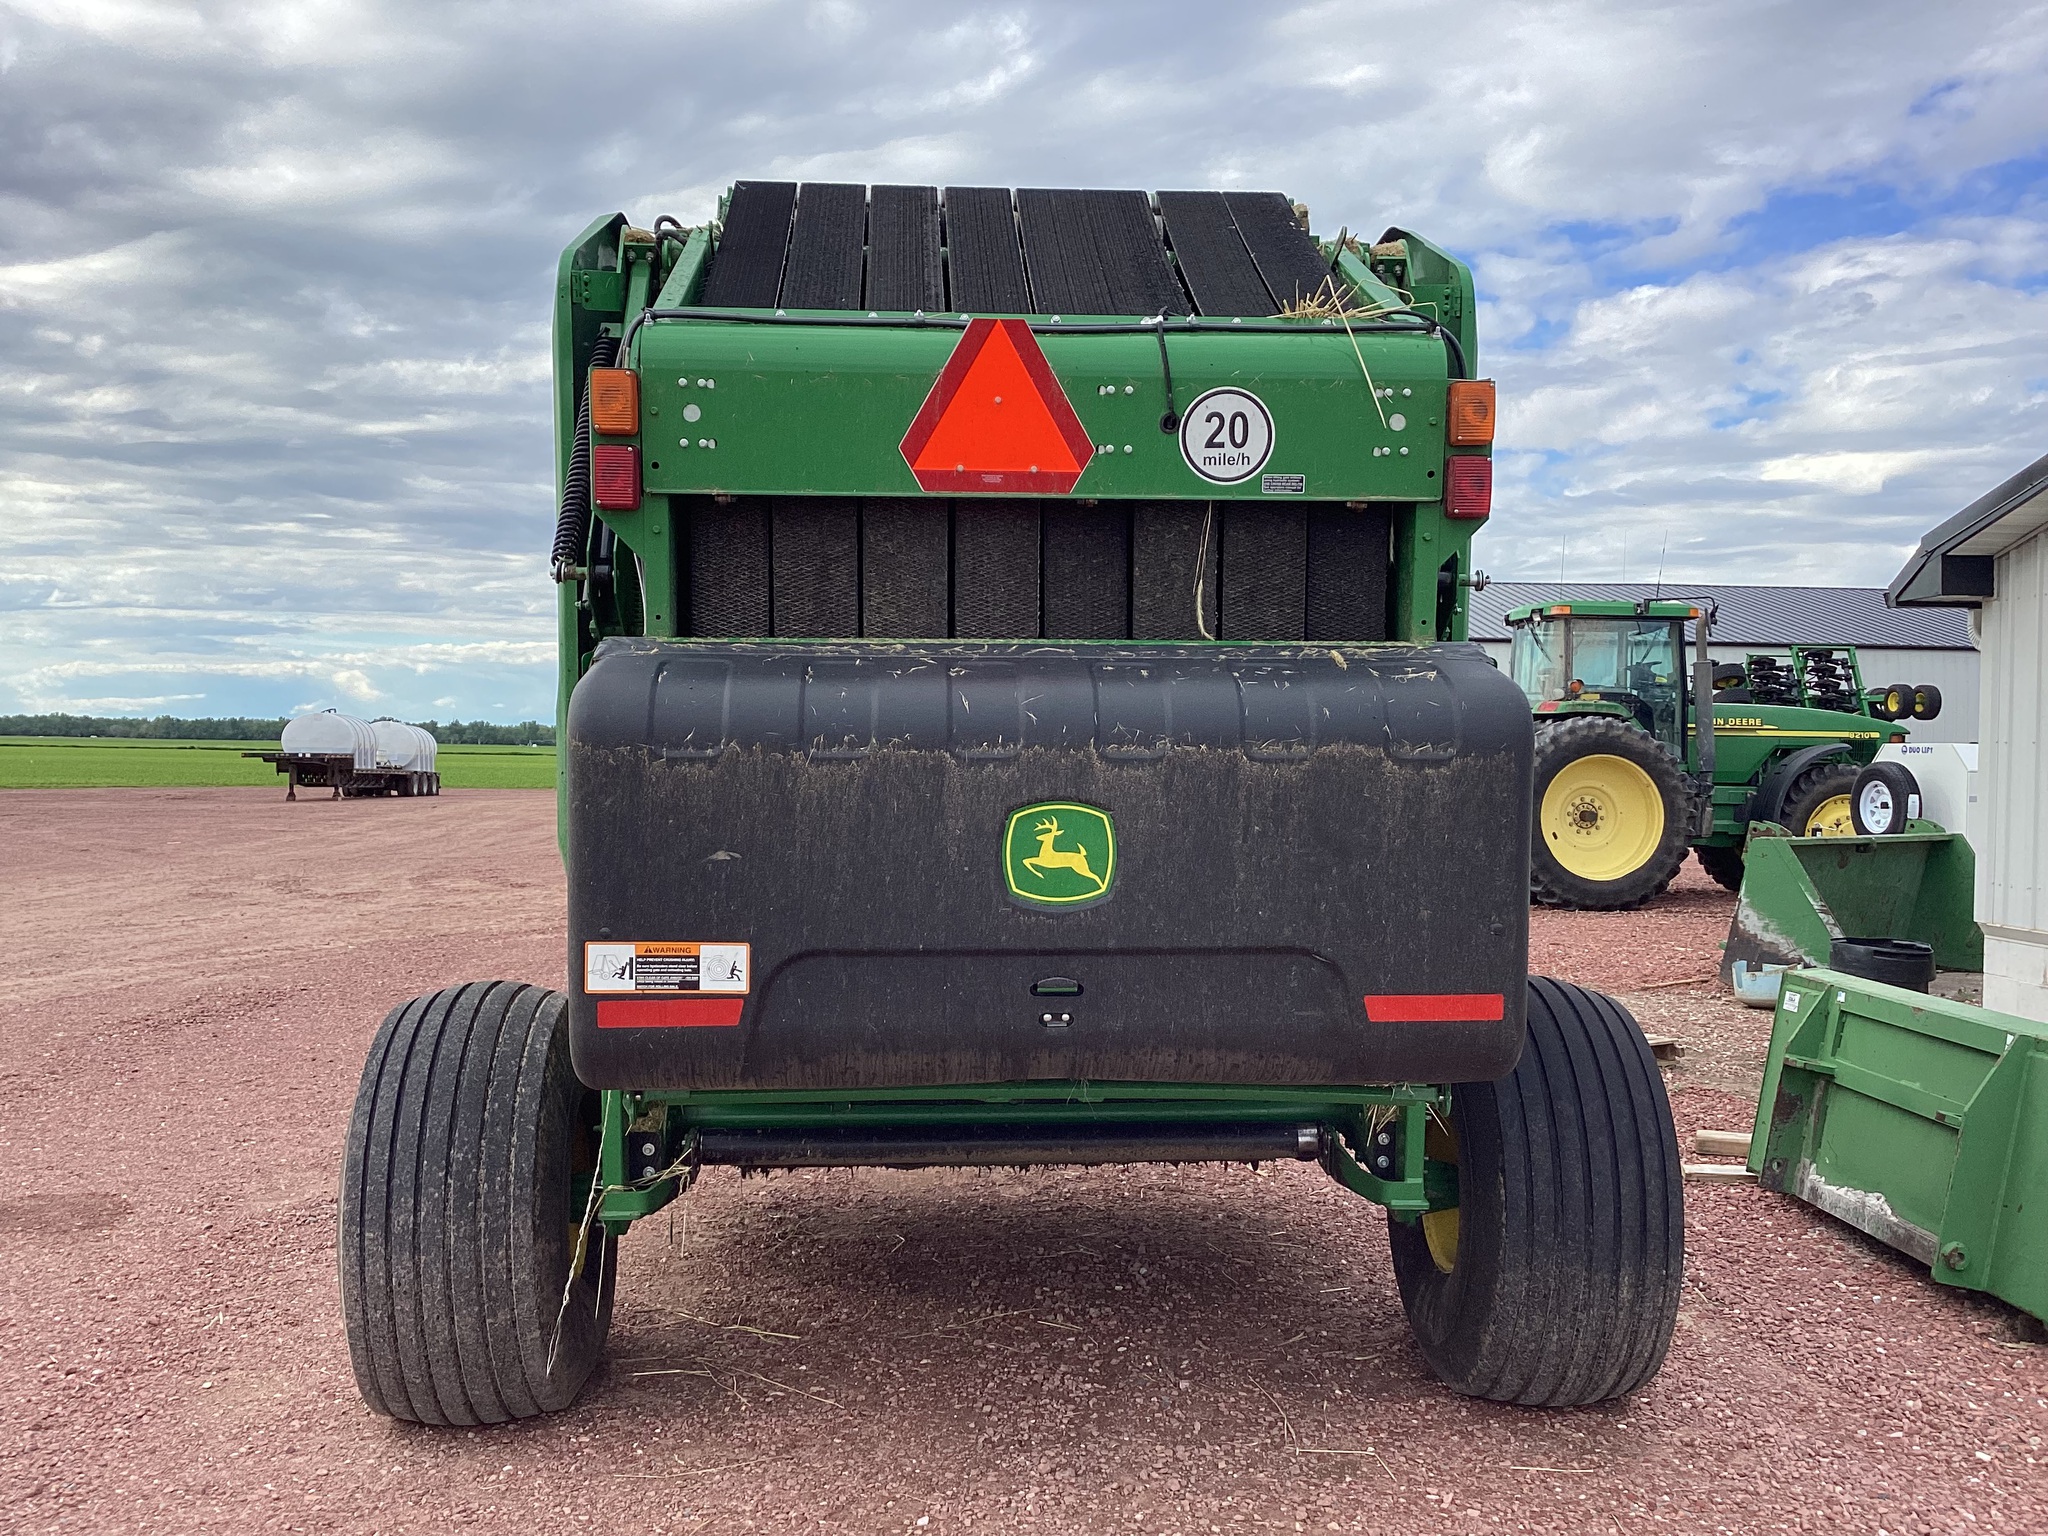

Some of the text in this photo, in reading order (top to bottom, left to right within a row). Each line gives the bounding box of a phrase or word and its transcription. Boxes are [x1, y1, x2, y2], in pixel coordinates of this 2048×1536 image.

[1204, 411, 1249, 449] 20
[1203, 452, 1251, 466] mile/h
[1728, 717, 1762, 726] DEERE
[652, 946, 692, 954] WARNING
